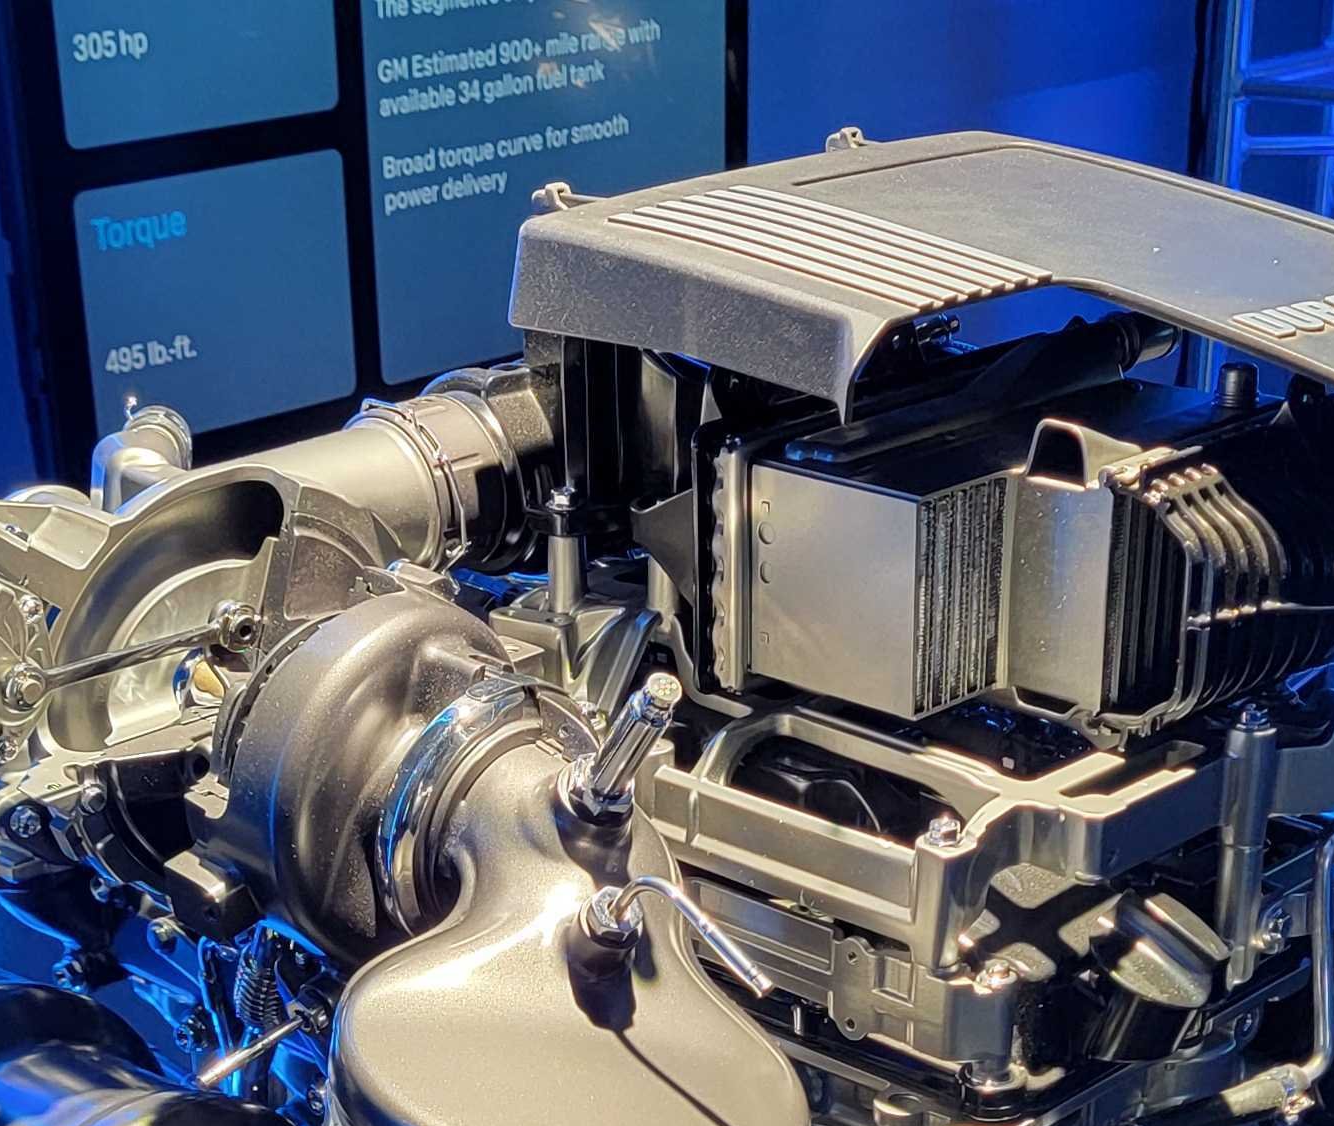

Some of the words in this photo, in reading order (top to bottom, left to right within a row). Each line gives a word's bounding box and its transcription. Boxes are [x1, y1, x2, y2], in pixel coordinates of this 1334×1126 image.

[375, 0, 409, 19] The
[411, 0, 488, 16] segme
[72, 30, 117, 62] 305
[118, 29, 148, 60] hp
[377, 58, 409, 84] GM
[411, 43, 497, 78] Estimated
[499, 38, 543, 65] 900+
[545, 32, 579, 57] mile
[628, 18, 661, 45] with
[379, 83, 456, 117] available
[458, 79, 481, 105] 34
[483, 72, 534, 104] gallon
[536, 63, 568, 91] fuel
[570, 59, 606, 87] tank
[382, 148, 436, 179] Broad
[438, 141, 495, 168] torque
[497, 133, 544, 158] curve
[546, 126, 569, 148] for
[570, 113, 629, 145] smooth
[384, 183, 439, 216] power
[441, 171, 508, 201] delivery
[90, 210, 188, 251] Torque
[105, 343, 146, 374] 495
